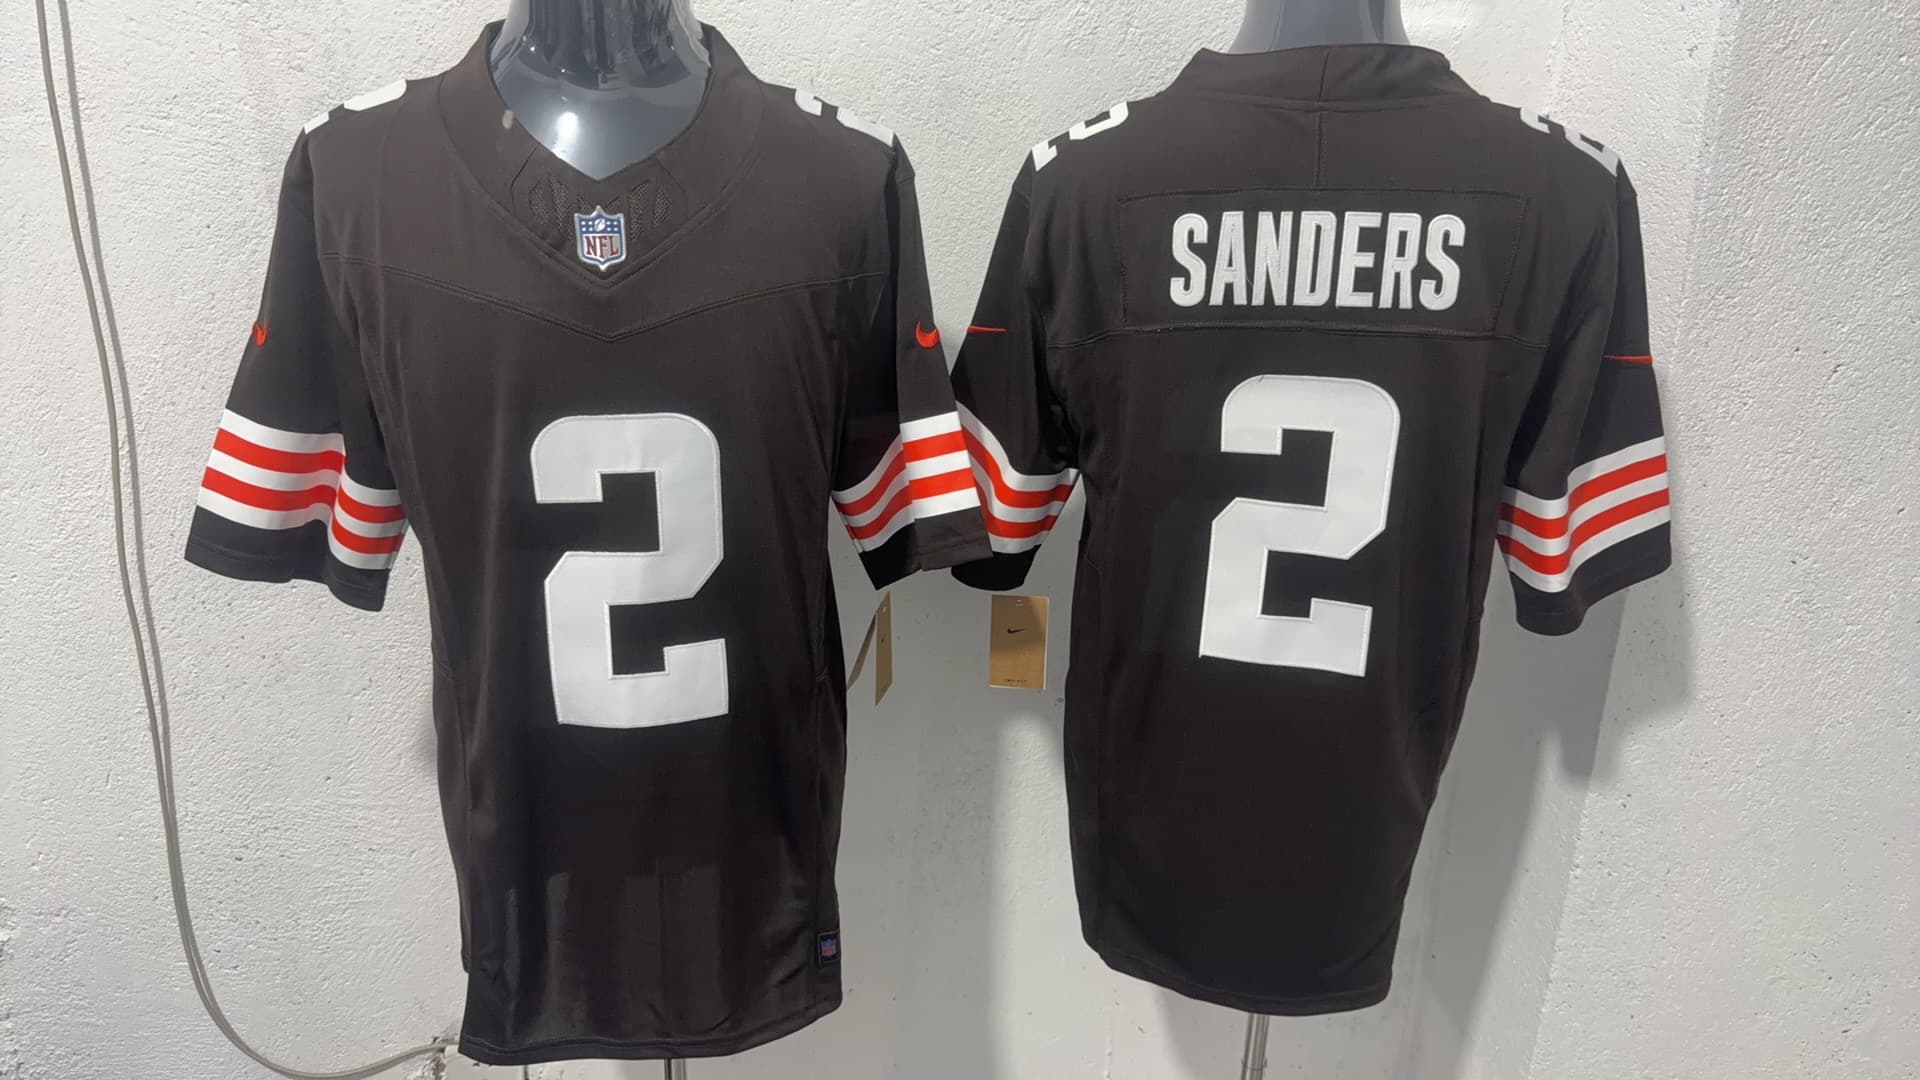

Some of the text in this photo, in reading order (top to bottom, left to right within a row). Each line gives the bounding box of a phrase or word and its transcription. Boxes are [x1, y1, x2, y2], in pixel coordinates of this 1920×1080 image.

[584, 235, 619, 258] NFL
[1169, 210, 1466, 311] SANDERS
[530, 412, 729, 729] 2
[1199, 374, 1401, 677] 2
